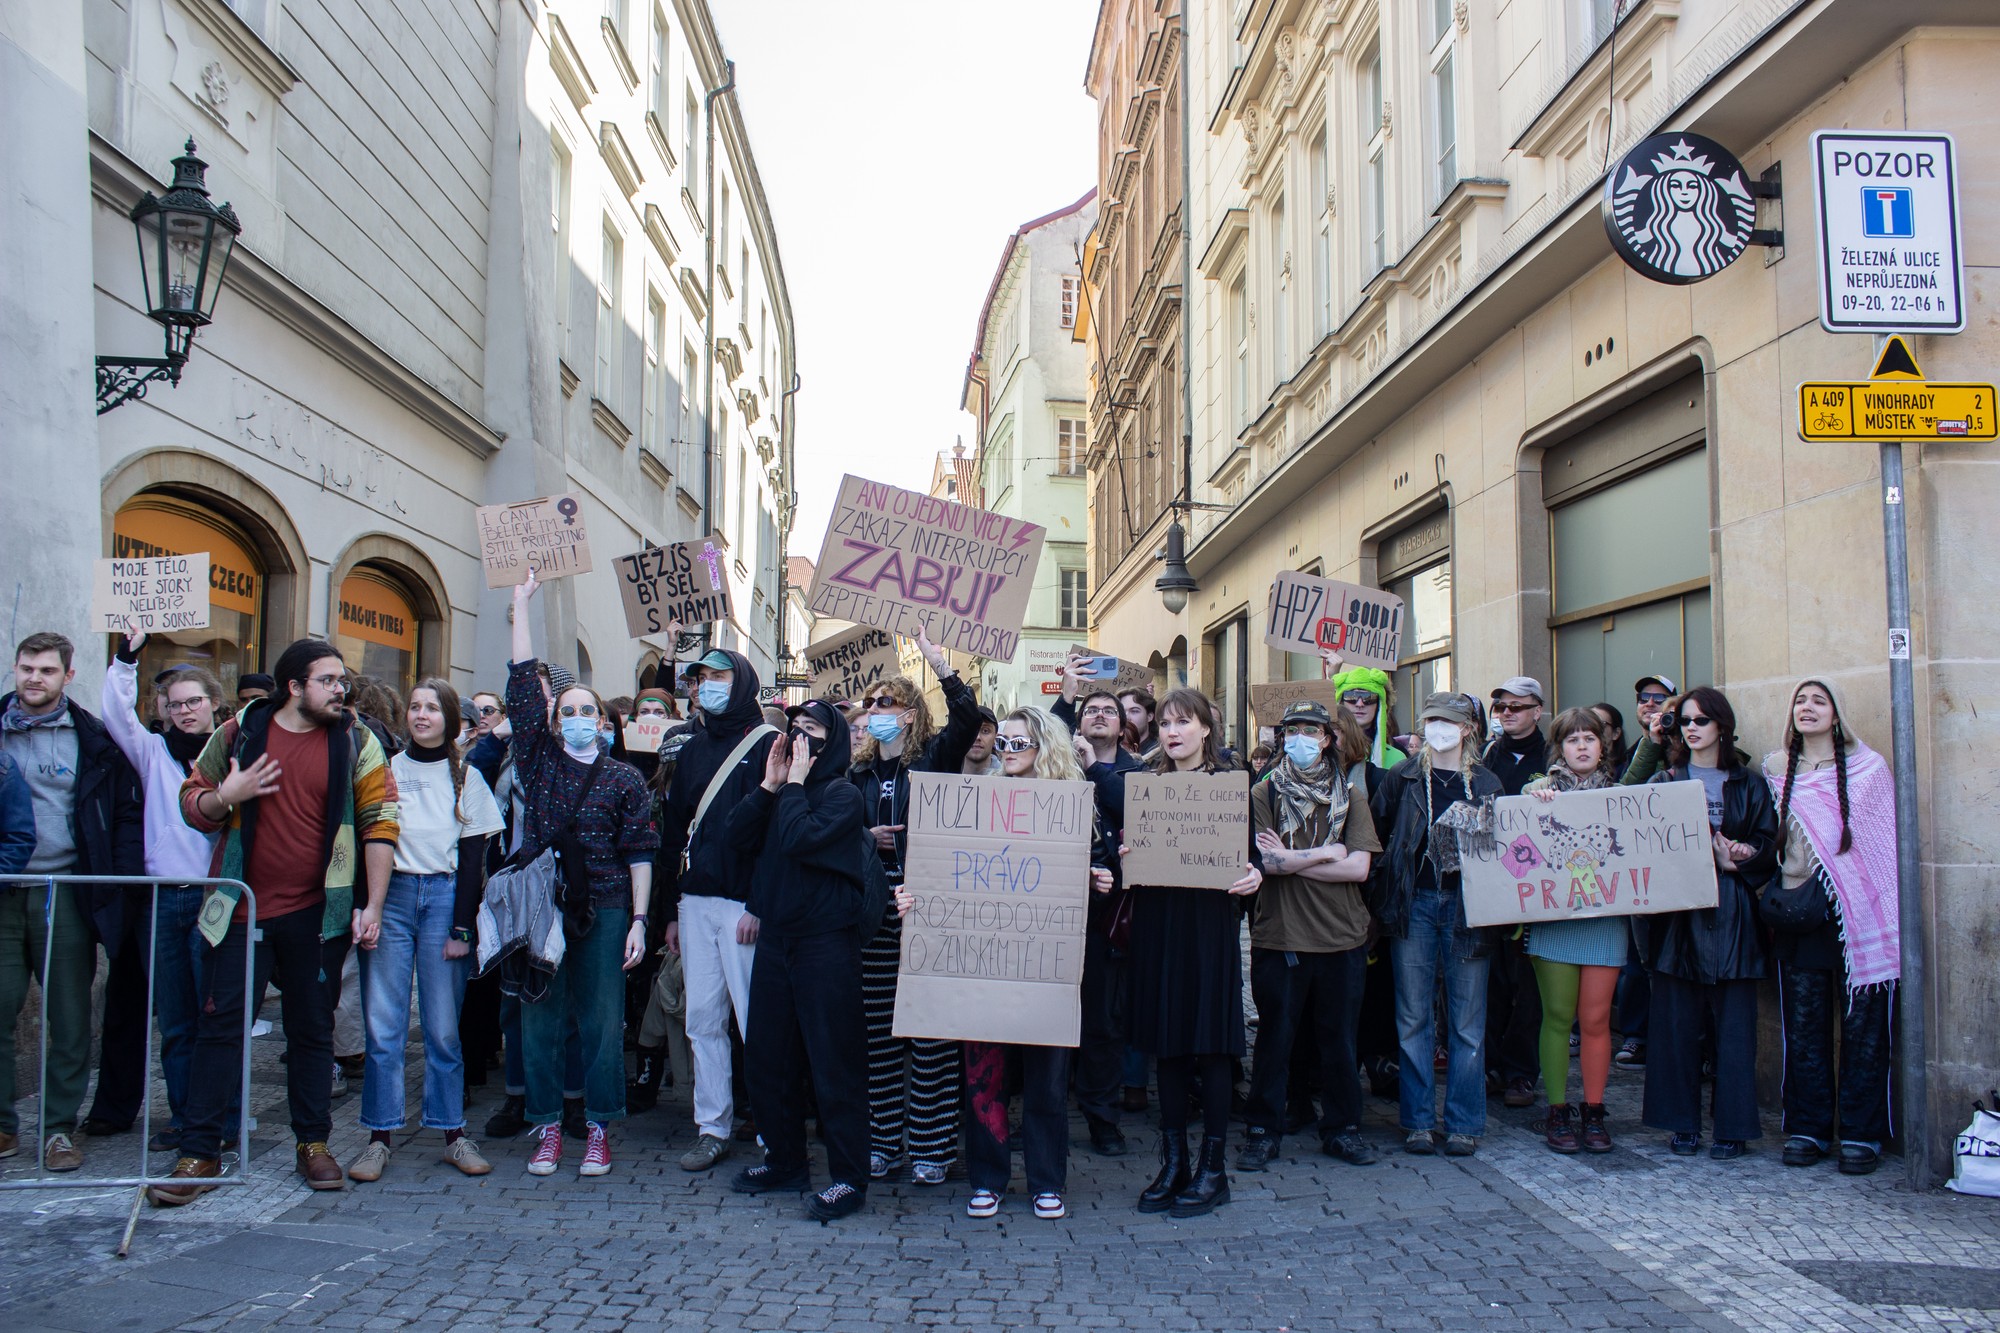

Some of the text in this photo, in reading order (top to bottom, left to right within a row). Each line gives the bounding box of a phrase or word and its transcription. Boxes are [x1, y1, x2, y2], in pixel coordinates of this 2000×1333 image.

[1834, 151, 1935, 178] POZOR
[1841, 246, 1940, 267] ŽELEZNÁ ULICE
[1847, 268, 1937, 289] NEPRŮJEZDNÁ
[1937, 296, 1945, 311] h
[1810, 392, 1844, 407] A 409
[1864, 393, 1982, 410] VINOHRADY 2
[1865, 410, 1916, 430] MŮSTEK
[1966, 414, 1983, 430] 0,5
[481, 505, 540, 526] I CAN'T
[856, 481, 1013, 546] ANI O JEDNU VÍC!
[482, 518, 558, 541] BELIEVE I'M
[1400, 523, 1440, 556] STARBUCKS
[486, 527, 585, 555] STILL PROTESTING
[834, 506, 1029, 578] ZÁKAZ INTERRUPCÍ
[112, 557, 189, 577] MOJE TĚLO,
[486, 545, 579, 574] THIS SHIT!
[622, 542, 692, 583] JEŽÍŠ
[113, 577, 193, 596] MOJE STORY.
[209, 564, 253, 598] CZECH
[637, 571, 700, 605] BY ŠEL
[829, 538, 1006, 623] ZABÍJÍ
[129, 595, 185, 612] NELÍBÍ?
[647, 593, 729, 633] S NÁMI!
[1270, 580, 1323, 644] HPŽ
[105, 611, 206, 630] TAK TO SORRY...
[338, 600, 404, 637] PRAGUE VIBES
[811, 582, 1020, 661] ZEPTEJTE SE V POLSKU
[810, 629, 889, 676] INTERRUPCE
[1030, 650, 1064, 659] Ristorante
[843, 660, 861, 678] DO
[1030, 664, 1054, 672] GIOVANNI
[1263, 685, 1308, 702] GREGOR
[638, 724, 660, 735] NO
[918, 777, 980, 831] MUŽI
[1132, 784, 1248, 804] ZA TO, ŽE CHCEME
[1140, 809, 1201, 822] AUTONOMII
[1137, 822, 1220, 837] TĚL A ŽIVOTŮ,
[1132, 836, 1179, 848] NÁS UŽ
[951, 845, 1042, 893] PRÁVO
[911, 895, 1083, 933] ROZHODOVAT
[908, 929, 1066, 980] O ŽENSKÉM TĚLE
